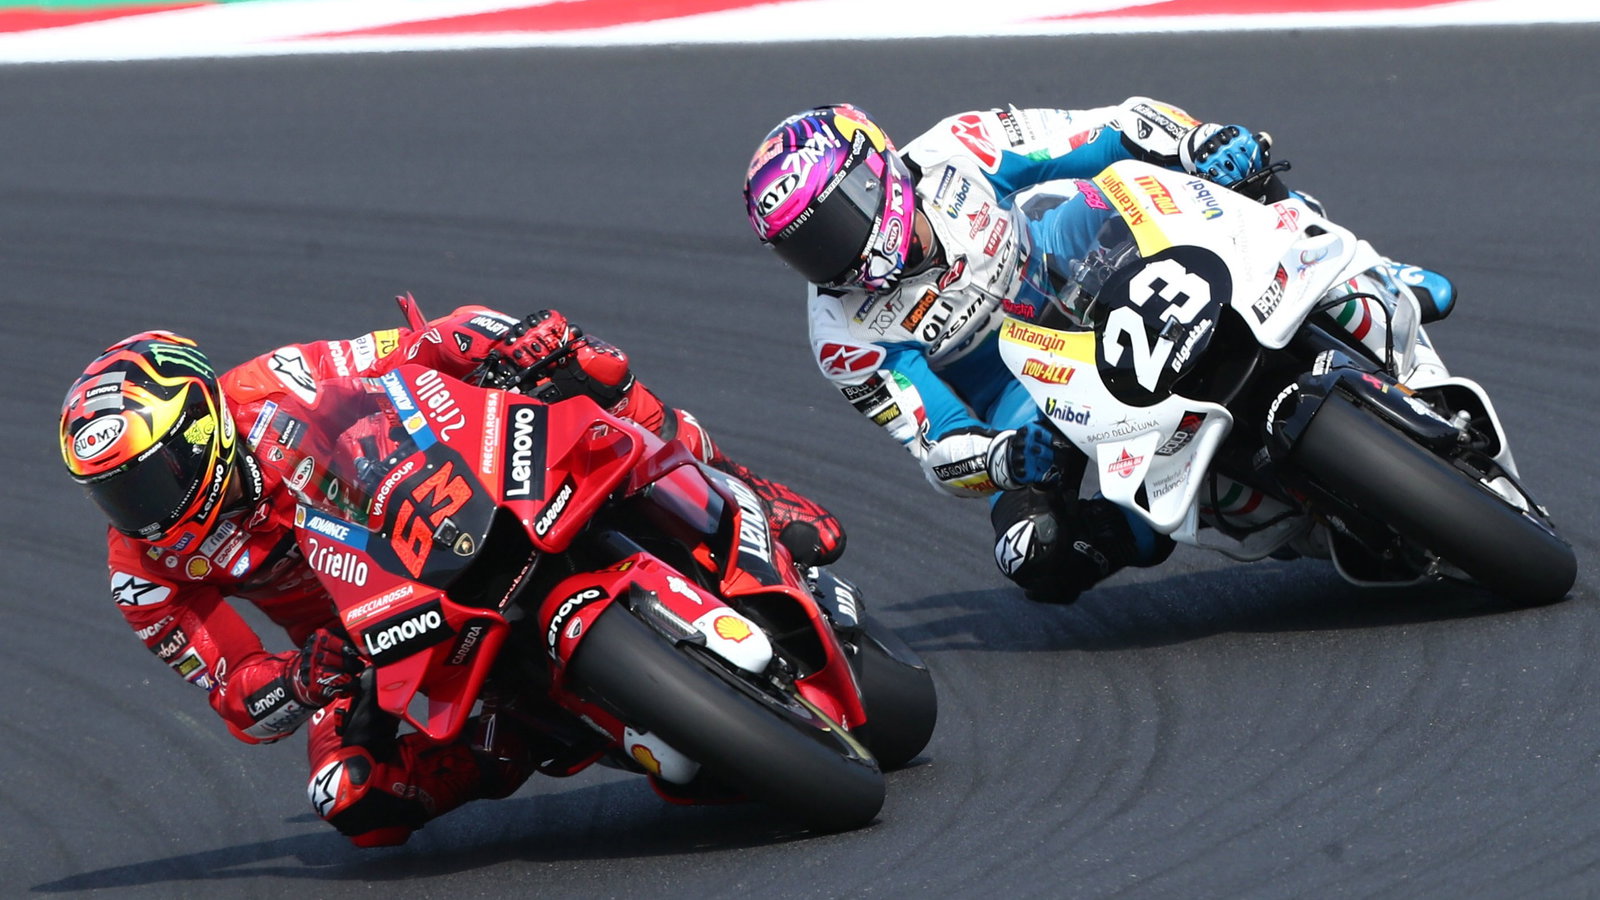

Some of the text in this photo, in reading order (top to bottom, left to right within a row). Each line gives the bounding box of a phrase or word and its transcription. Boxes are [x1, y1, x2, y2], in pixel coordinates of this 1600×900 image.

[758, 179, 790, 216] KYT
[947, 176, 972, 220] Unibat
[1102, 174, 1146, 227] Antangin
[1134, 176, 1183, 215] YOU-ALL
[1186, 179, 1224, 221] Unibat
[779, 207, 815, 240] TERRANOVA
[887, 223, 899, 250] PATA
[903, 291, 938, 332] Kapriol
[1255, 280, 1281, 313] BOLD
[929, 293, 986, 355] GRESINI
[1007, 322, 1066, 352] Antangin
[1102, 258, 1212, 393] 23
[86, 384, 118, 399] Lenovo
[380, 371, 415, 411] ADVANCE
[1022, 358, 1075, 385] YOU-ALL
[1044, 396, 1091, 427] Unibat
[1112, 424, 1138, 438] DELLA
[1138, 419, 1159, 432] LUNA
[1266, 383, 1299, 436] DUCATI
[74, 424, 120, 453] SUOMY
[280, 419, 296, 444] Lenovo
[482, 392, 499, 475] FRECCIAROSSA
[1161, 430, 1186, 456] BOLD
[506, 407, 535, 497] Lenovo
[1108, 456, 1133, 473] FEDERAL
[198, 464, 225, 519] Lenovo
[246, 455, 263, 501] Lenovo
[372, 461, 414, 517] VARGROUP
[307, 515, 350, 541] ADVANCE
[390, 461, 473, 579] 63
[535, 484, 573, 536] CARRERA
[726, 477, 770, 563] Lenovo
[231, 556, 250, 578] SAP
[346, 584, 415, 622] FRECCIAROSSA
[364, 609, 442, 657] Lenovo
[547, 589, 600, 660] Lenovo
[452, 625, 483, 665] CARRERA
[249, 686, 286, 717] Lenovo
